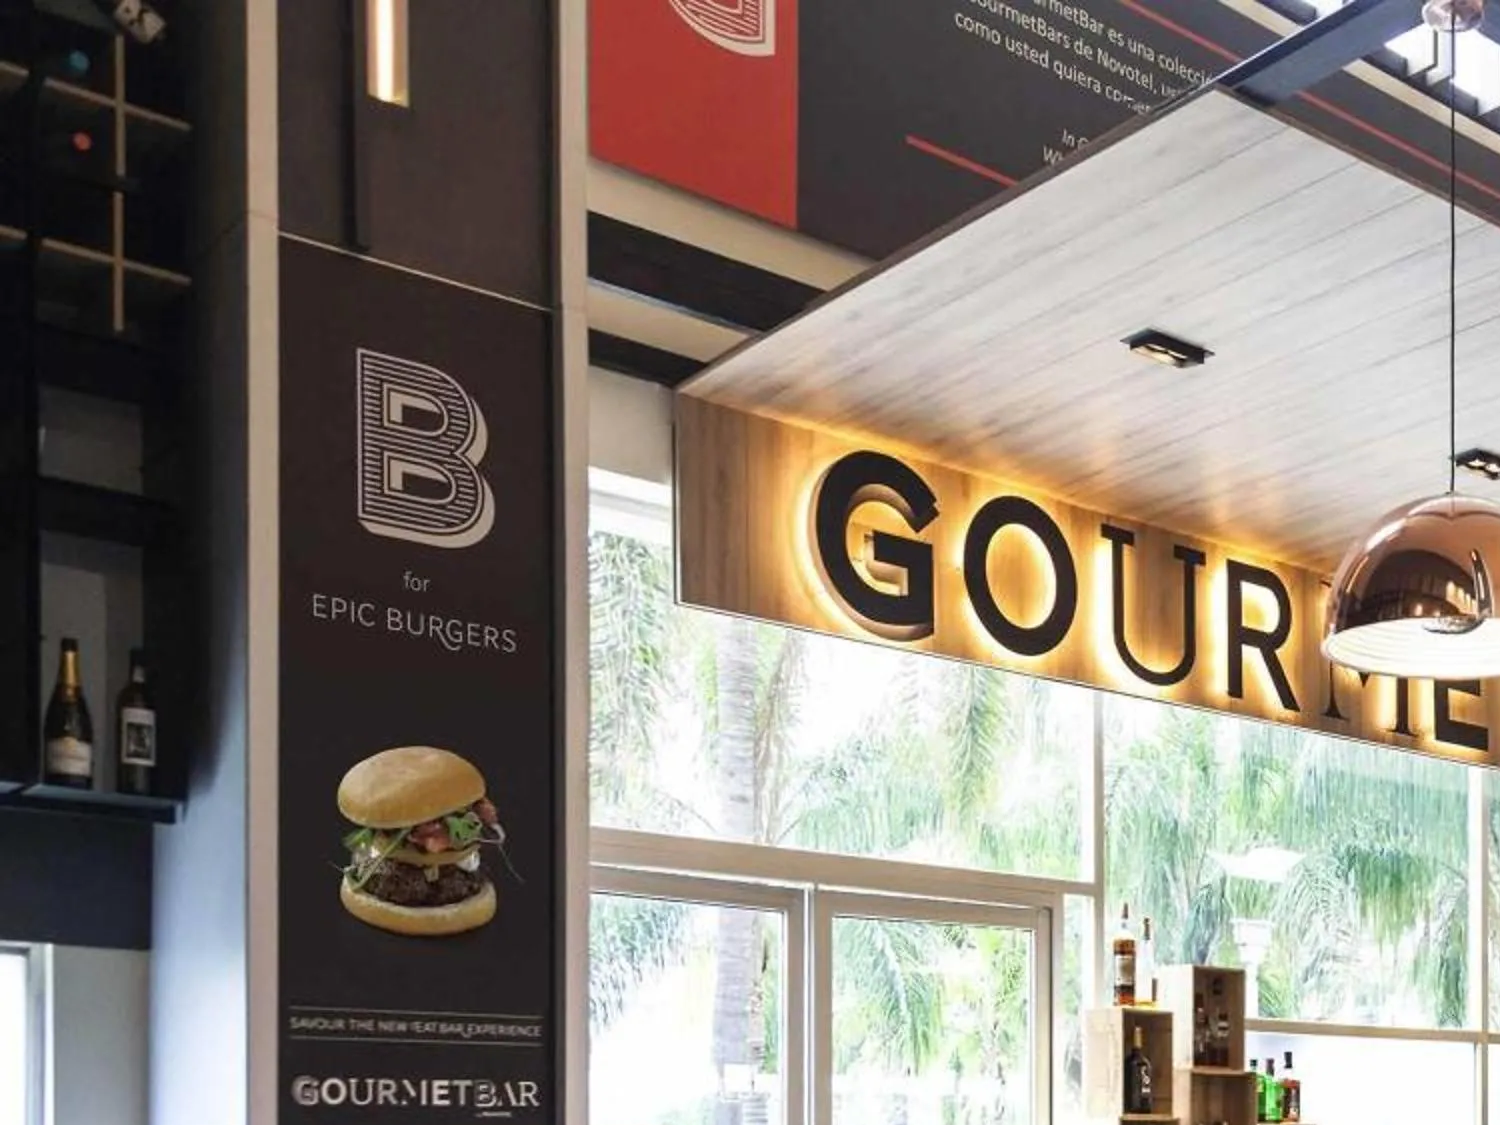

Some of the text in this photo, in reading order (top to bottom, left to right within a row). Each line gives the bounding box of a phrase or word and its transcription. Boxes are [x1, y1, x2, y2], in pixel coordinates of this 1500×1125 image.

[955, 12, 1001, 45] como
[1005, 36, 1049, 69] usted
[1053, 60, 1101, 94] quiera
[1073, 37, 1093, 61] de
[1097, 48, 1157, 94] Novotel,
[1107, 28, 1125, 48] es
[1128, 39, 1154, 63] una
[357, 347, 496, 549] B
[404, 571, 430, 592] for
[312, 593, 518, 653] EPIC BURGERS
[349, 1018, 376, 1032] THE
[378, 1020, 408, 1033] NEW
